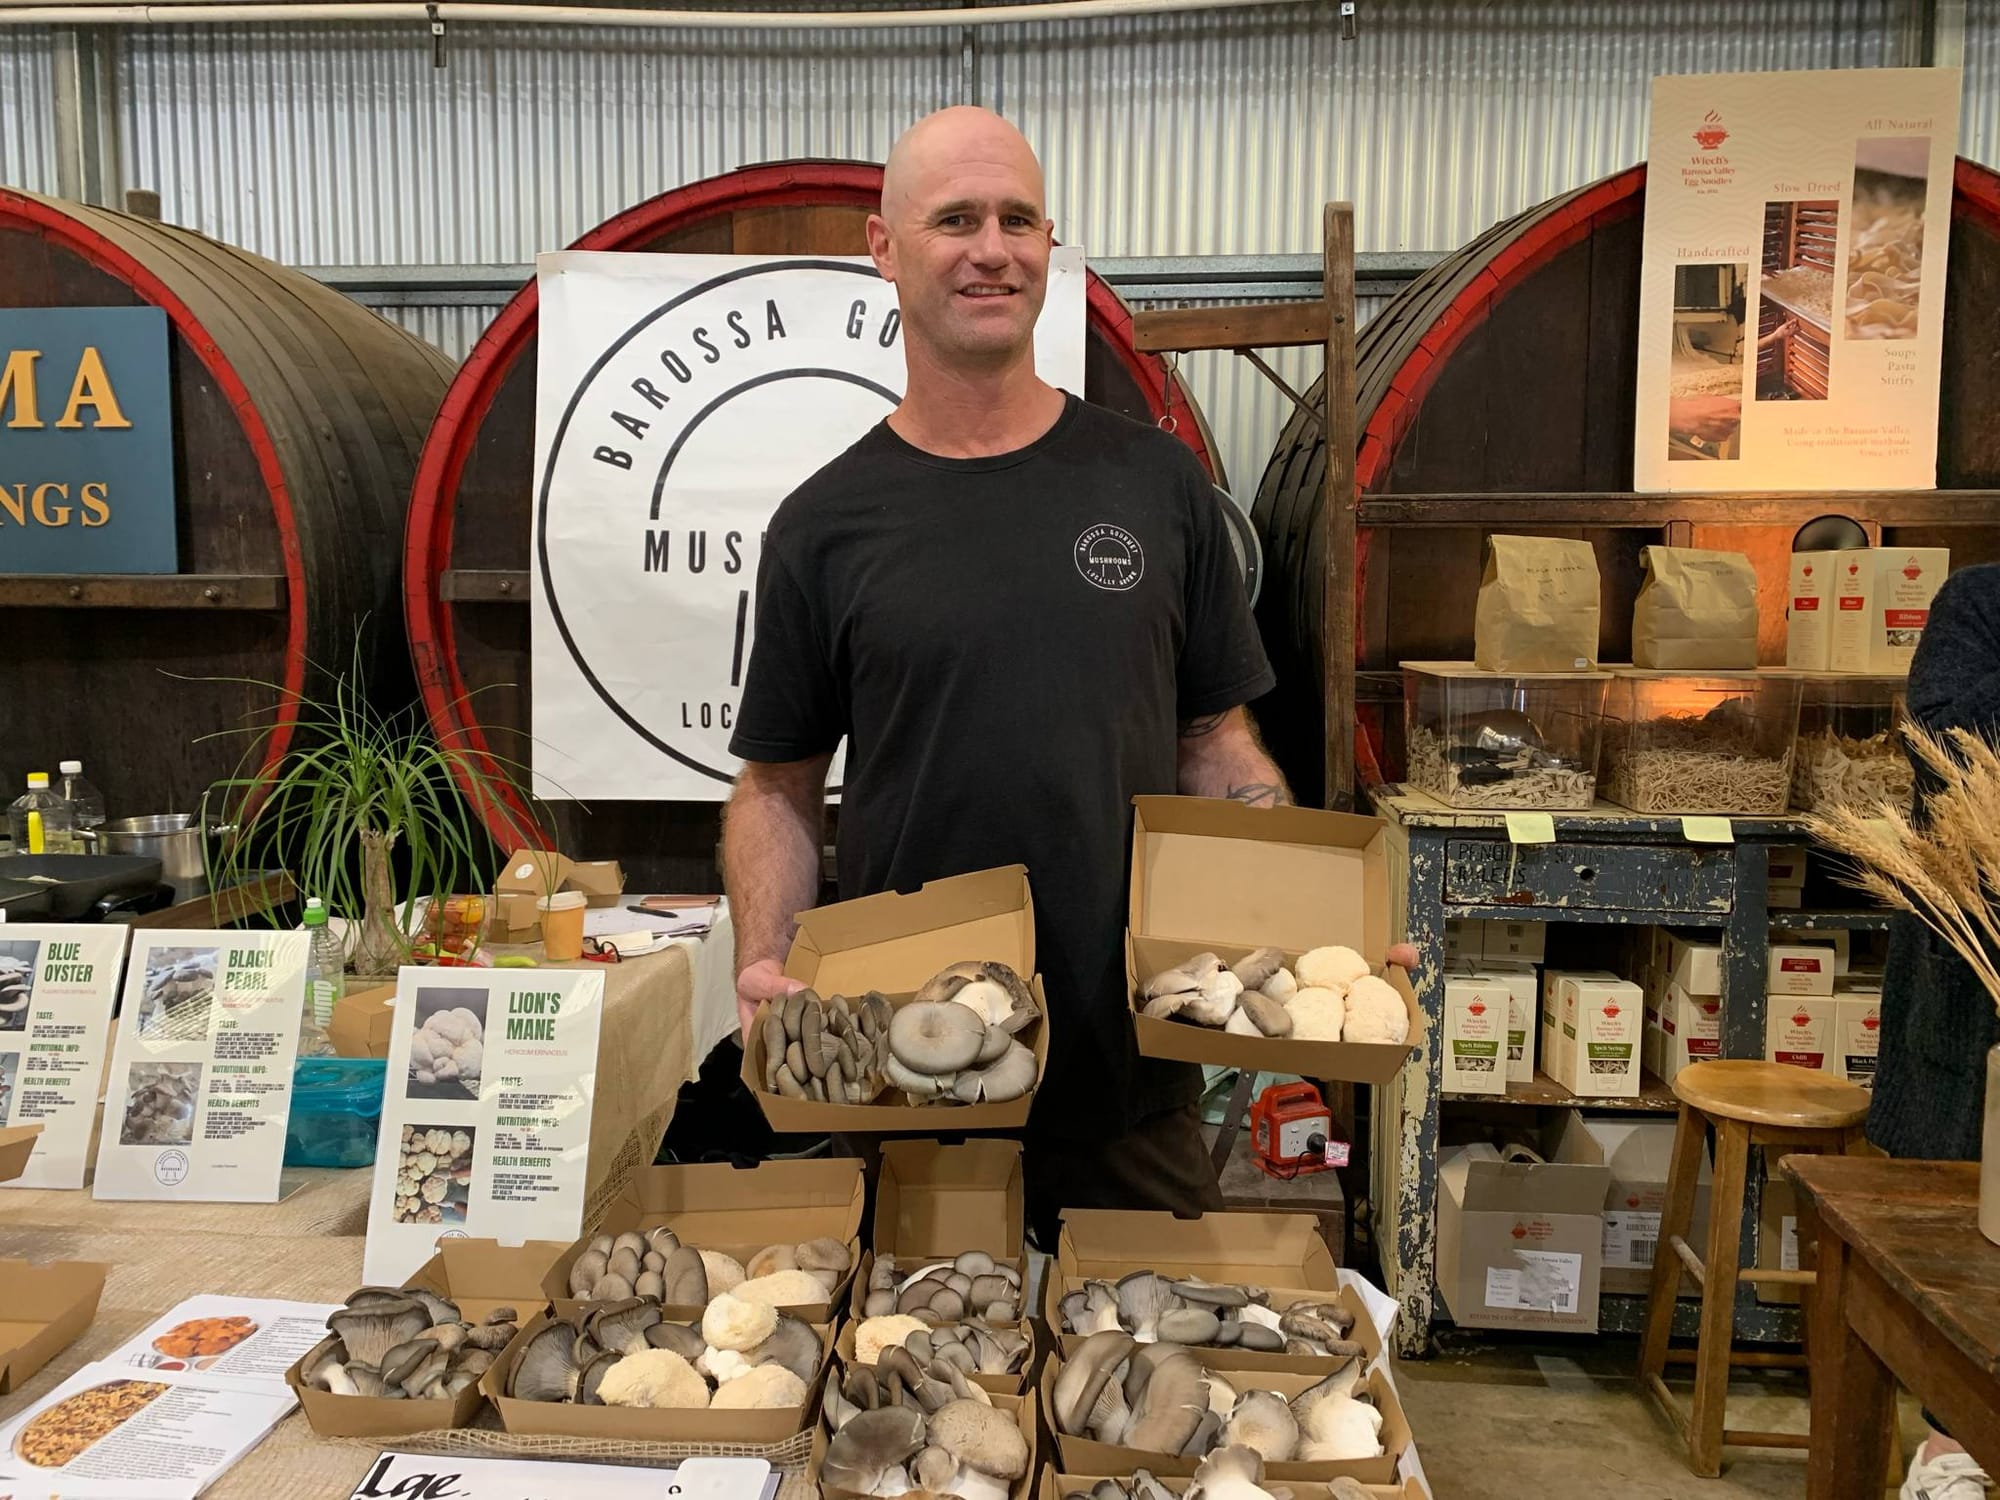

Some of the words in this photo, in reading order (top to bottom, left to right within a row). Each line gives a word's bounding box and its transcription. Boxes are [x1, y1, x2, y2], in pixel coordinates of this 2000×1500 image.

[1889, 119, 1933, 129] Natural
[1774, 183, 1800, 193] Slow
[1807, 181, 1841, 193] Dried
[1677, 246, 1750, 257] Handcrafted
[1884, 348, 1917, 360] Soups
[1888, 361, 1916, 371] Pasta
[592, 298, 787, 471] BAROSSA
[0, 482, 111, 527] NGS
[644, 529, 767, 574] MUS
[1088, 556, 1132, 566] MUSHROOMS
[47, 942, 81, 961] BLUE
[228, 950, 274, 968] BLACK
[44, 964, 94, 982] OYSTER
[225, 971, 268, 990] PEARL
[509, 992, 561, 1014] LION'S
[506, 1018, 556, 1040] MANE
[492, 1156, 518, 1166] HEALTH
[520, 1157, 552, 1167] BENEFITS
